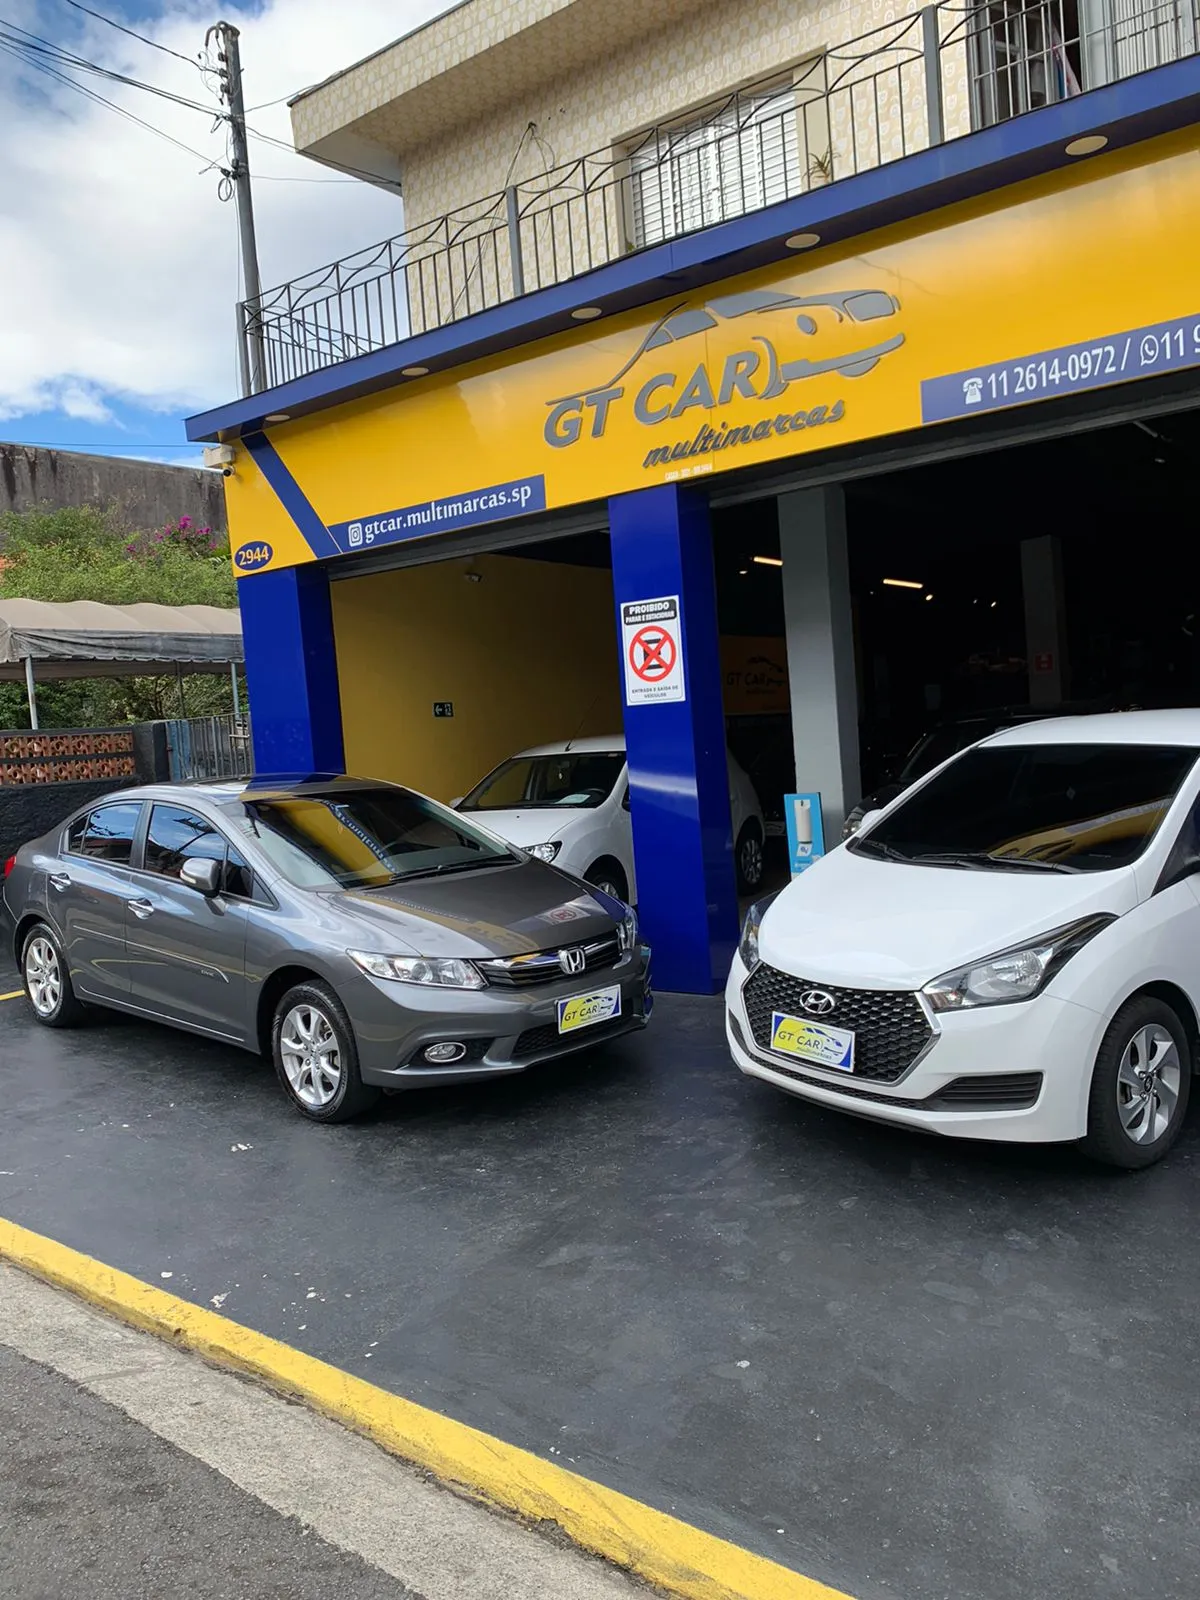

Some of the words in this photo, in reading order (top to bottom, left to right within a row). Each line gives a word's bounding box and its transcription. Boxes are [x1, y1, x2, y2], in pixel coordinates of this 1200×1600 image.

[988, 371, 1008, 398] 11
[1014, 346, 1116, 393] 2614-0972
[1160, 328, 1185, 361] 11
[544, 387, 624, 448] GT
[633, 350, 762, 426] CAR
[642, 399, 845, 469] multimarcas
[238, 545, 270, 567] 2944
[629, 601, 670, 615] PROIBIDO
[726, 671, 742, 686] GT
[564, 1010, 578, 1022] GT
[579, 1005, 598, 1017] CAR
[778, 1030, 794, 1041] GT
[796, 1036, 820, 1049] CAR
